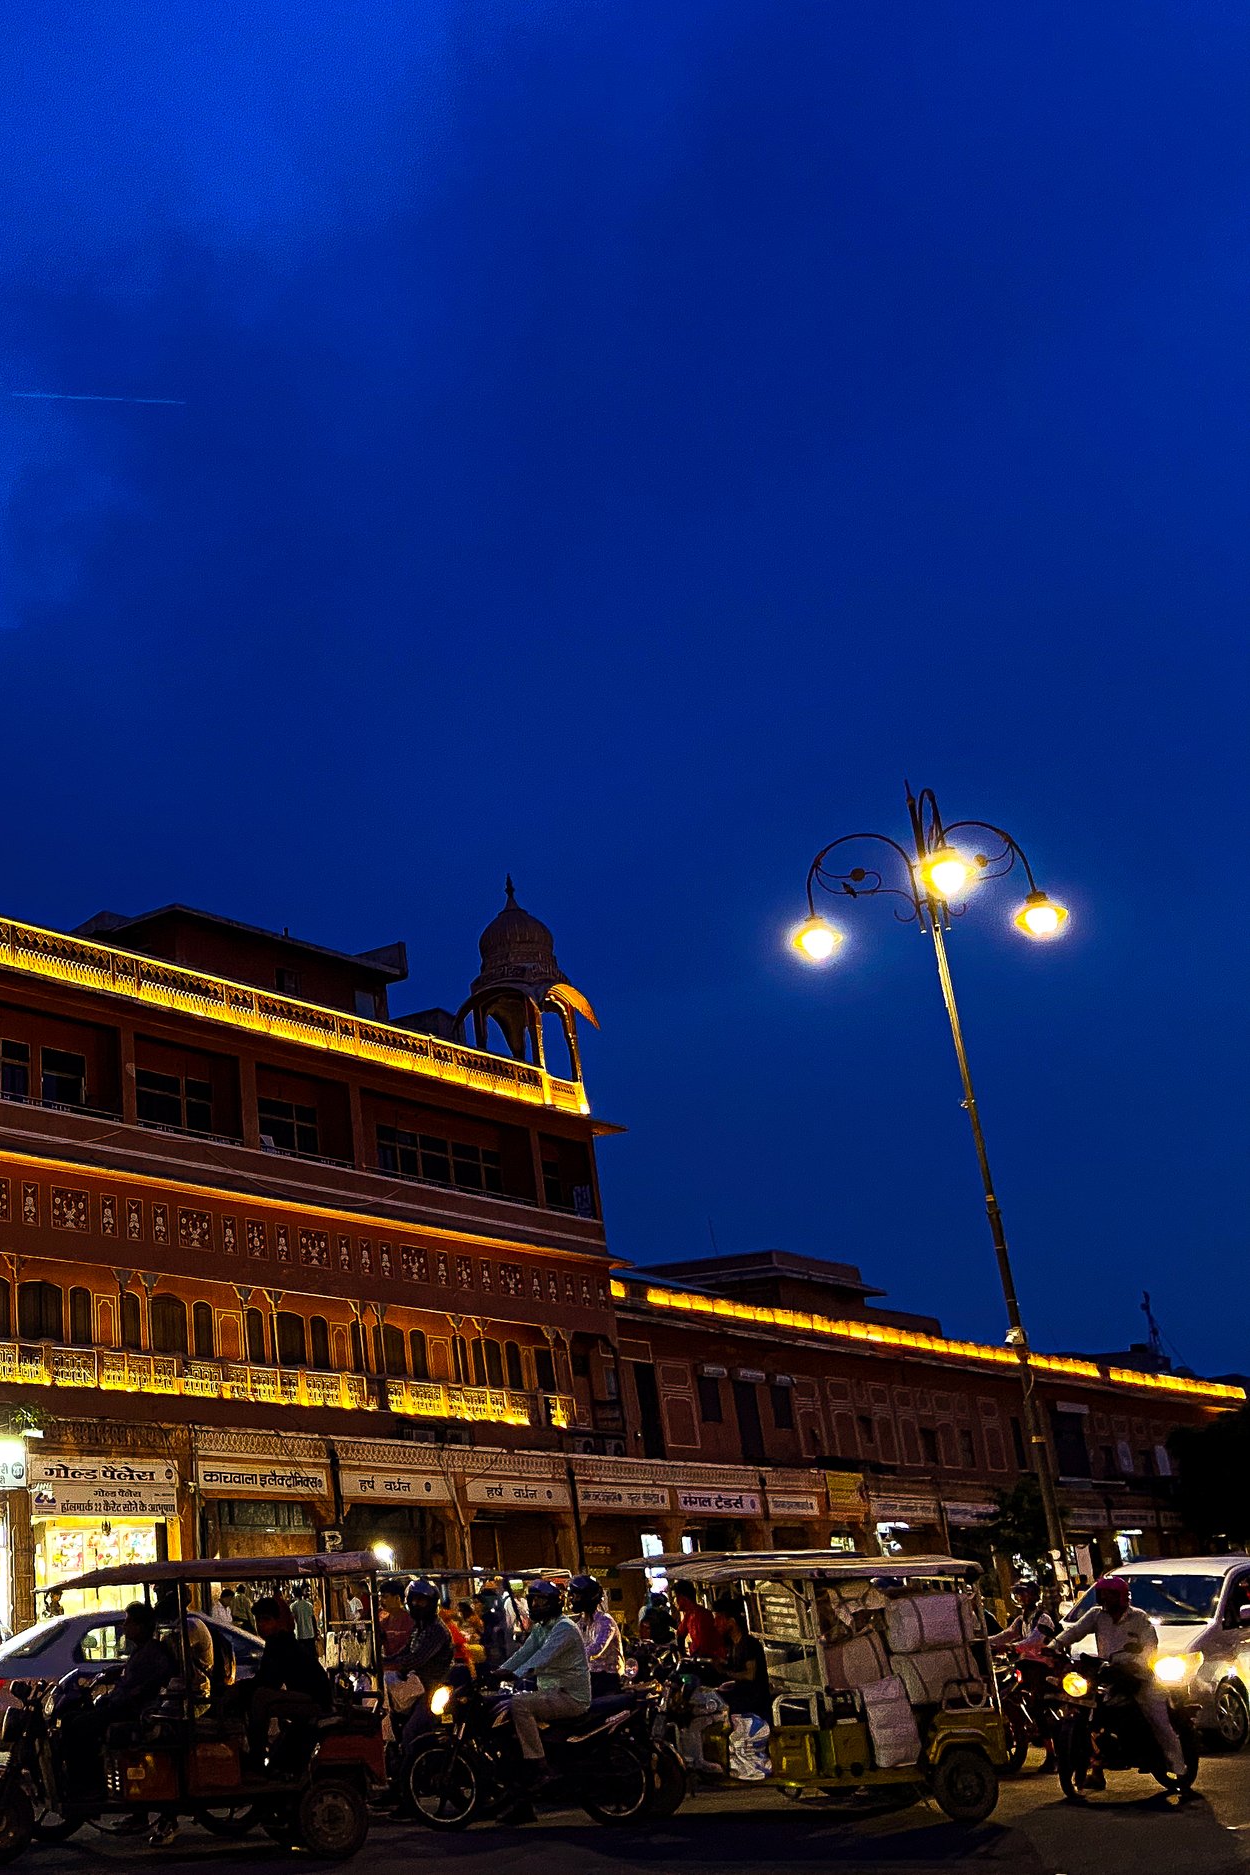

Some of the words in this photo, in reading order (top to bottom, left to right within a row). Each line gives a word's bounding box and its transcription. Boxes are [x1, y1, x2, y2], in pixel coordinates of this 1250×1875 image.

[44, 1464, 98, 1480] गोल्ड
[102, 1465, 155, 1481] पैलेस
[203, 1470, 258, 1485] काचवाला
[359, 1476, 375, 1491] हर्ष
[384, 1478, 411, 1492] वर्धन
[485, 1484, 503, 1498] हर्ष
[513, 1485, 538, 1499] वर्धन
[104, 1501, 122, 1513] कैरेट
[122, 1500, 139, 1512] सोने
[139, 1500, 147, 1512] के
[148, 1503, 175, 1515] आभूषण
[682, 1493, 711, 1507] मंगल
